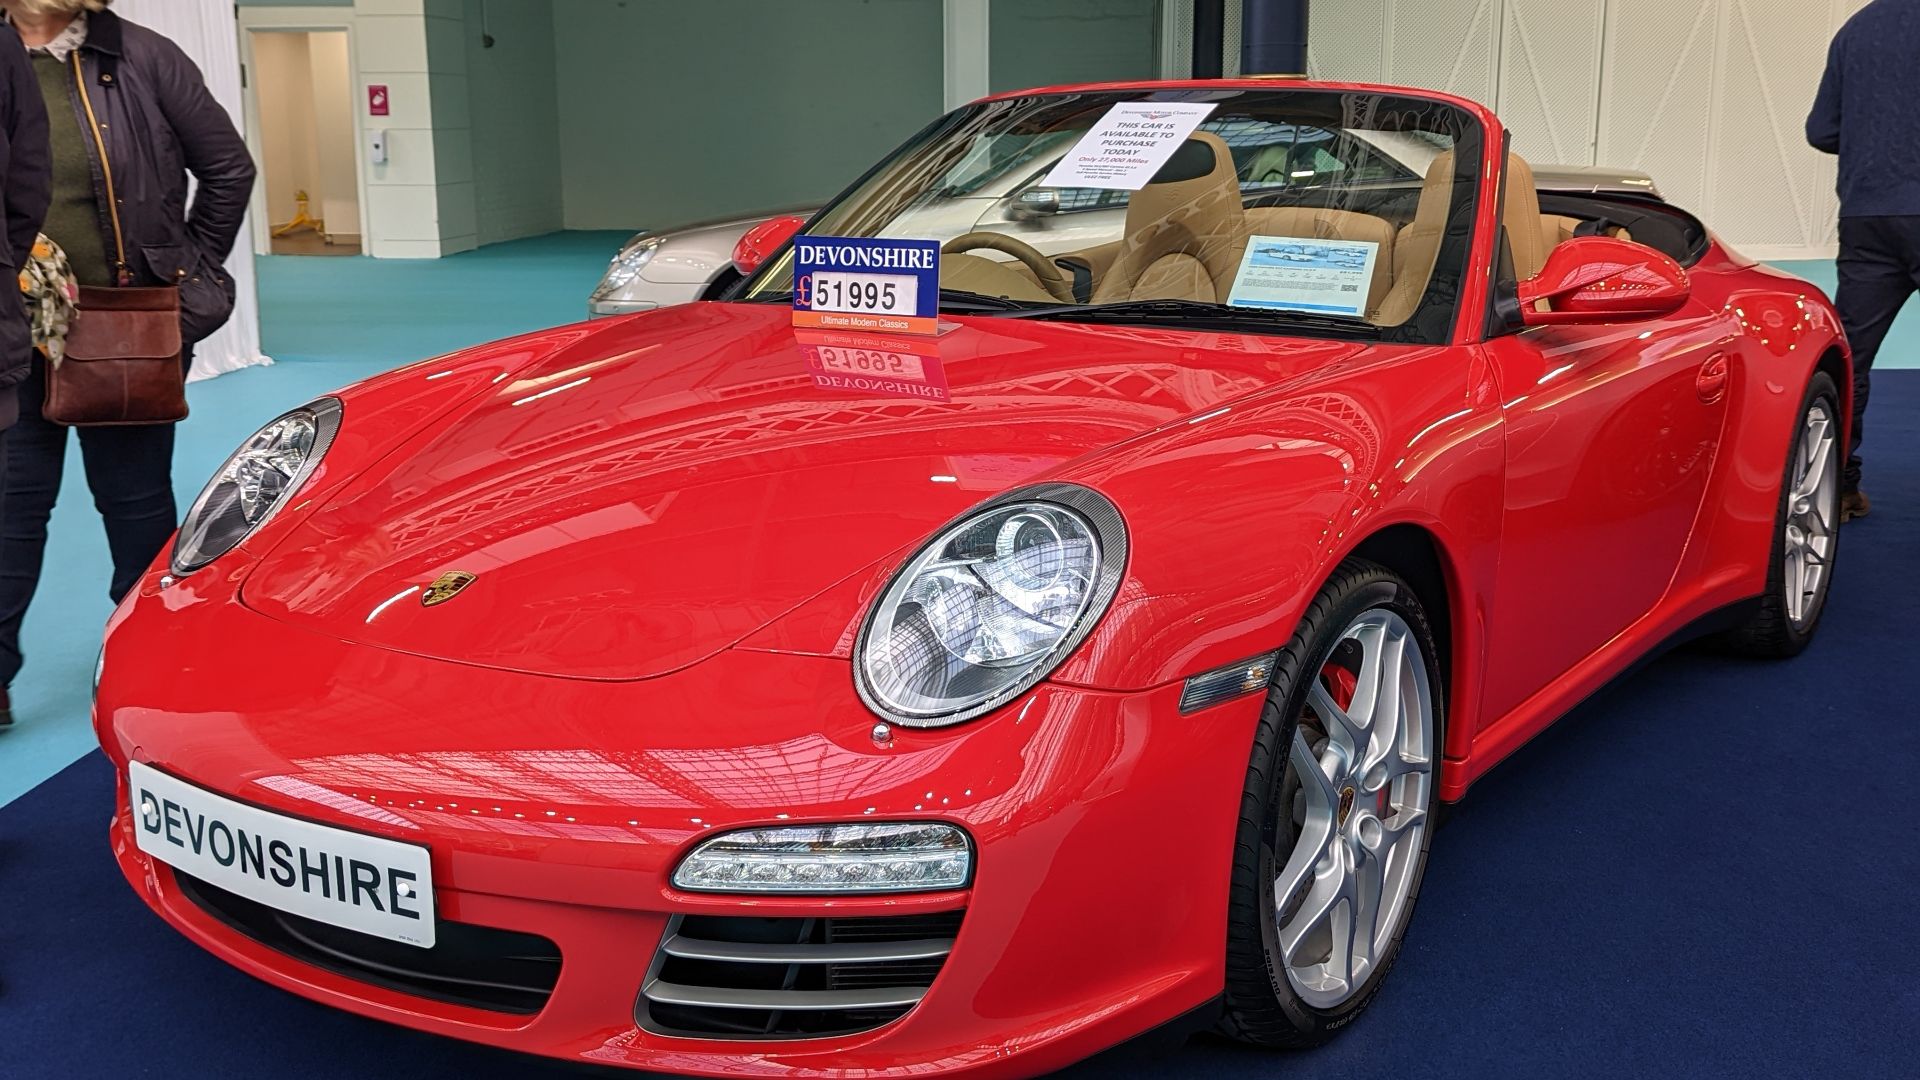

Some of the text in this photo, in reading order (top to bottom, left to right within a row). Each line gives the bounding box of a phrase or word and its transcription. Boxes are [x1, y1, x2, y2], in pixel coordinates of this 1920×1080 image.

[1099, 130, 1175, 139] AVAILABLE TO
[1100, 139, 1158, 147] PURCHASE
[1126, 157, 1149, 165] Miles
[800, 245, 934, 269] DEVONSHIRE
[820, 315, 909, 329] Ultimate Modern Classics
[140, 788, 420, 920] DEVONSHIRE
